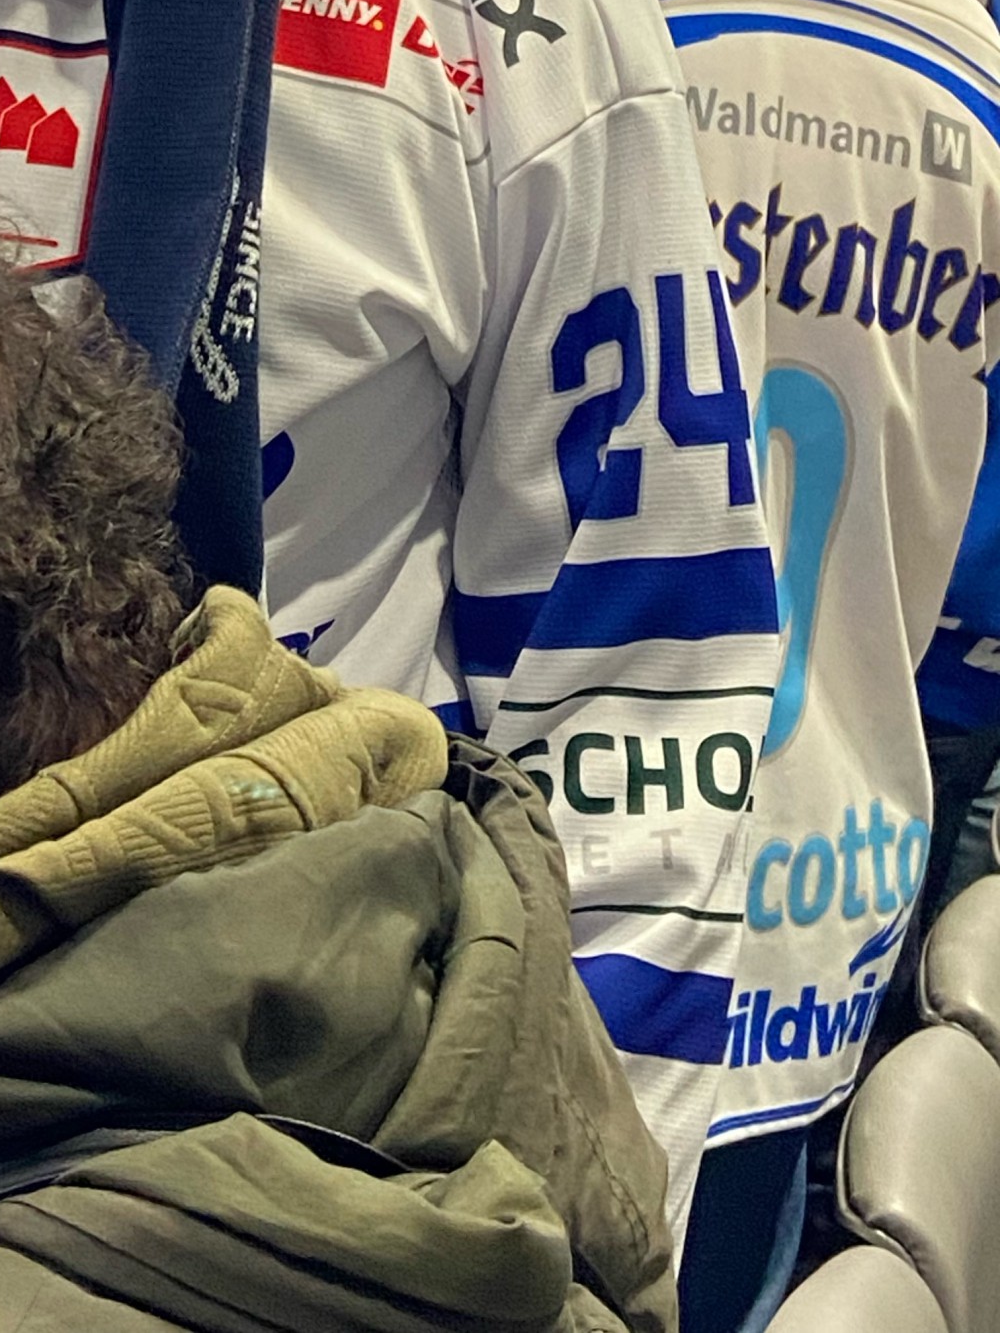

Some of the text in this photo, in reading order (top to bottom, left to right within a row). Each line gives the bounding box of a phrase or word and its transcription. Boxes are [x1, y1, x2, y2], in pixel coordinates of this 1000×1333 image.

[685, 85, 912, 169] Waldmann
[551, 269, 756, 535] 24
[507, 731, 766, 816] SCHO
[746, 796, 931, 933] cotto
[726, 972, 890, 1070] ildwi
